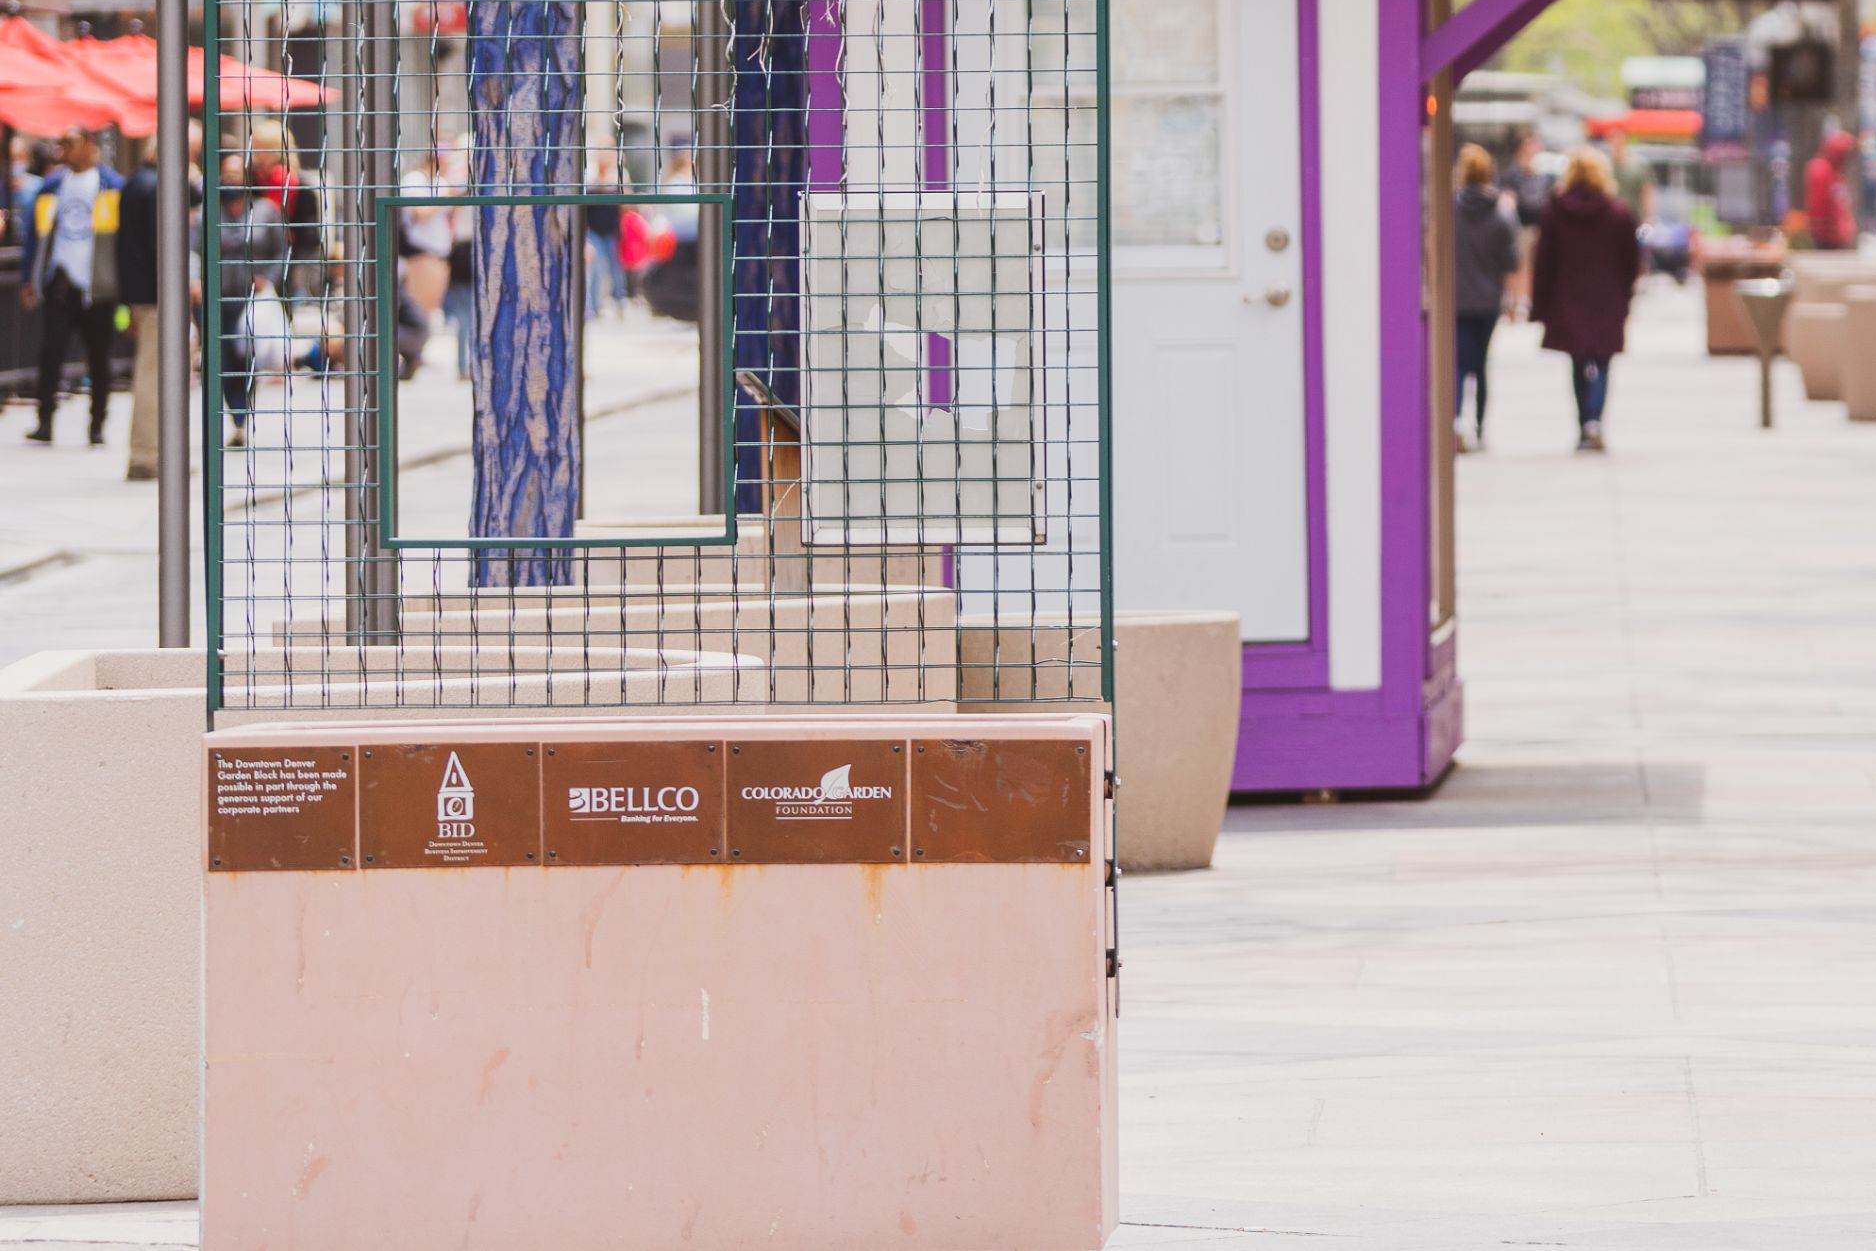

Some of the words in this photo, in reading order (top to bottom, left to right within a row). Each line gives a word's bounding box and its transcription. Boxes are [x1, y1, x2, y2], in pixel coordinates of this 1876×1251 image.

[217, 758, 233, 769] The
[235, 758, 281, 769] Downtown
[284, 757, 316, 768] Denver
[217, 770, 251, 780] Garden
[254, 769, 278, 780] Block
[280, 769, 295, 779] has
[297, 769, 320, 779] been
[322, 768, 347, 779] made
[217, 781, 253, 794] possible
[255, 782, 264, 791] in
[265, 782, 285, 793] part
[286, 780, 321, 793] through
[322, 780, 337, 790] the
[741, 786, 826, 800] COLORADO
[830, 786, 892, 800] GARDEN
[217, 794, 258, 805] generous
[260, 793, 294, 804] support
[295, 792, 305, 802] of
[307, 793, 323, 802] our
[591, 786, 700, 813] BELLCO
[217, 806, 261, 816] corporate
[263, 804, 300, 816] partners
[775, 805, 853, 815] FOUNDATION
[620, 815, 651, 825] Banking
[651, 814, 663, 823] for
[664, 814, 699, 824] Everyone.
[437, 822, 476, 838] BID
